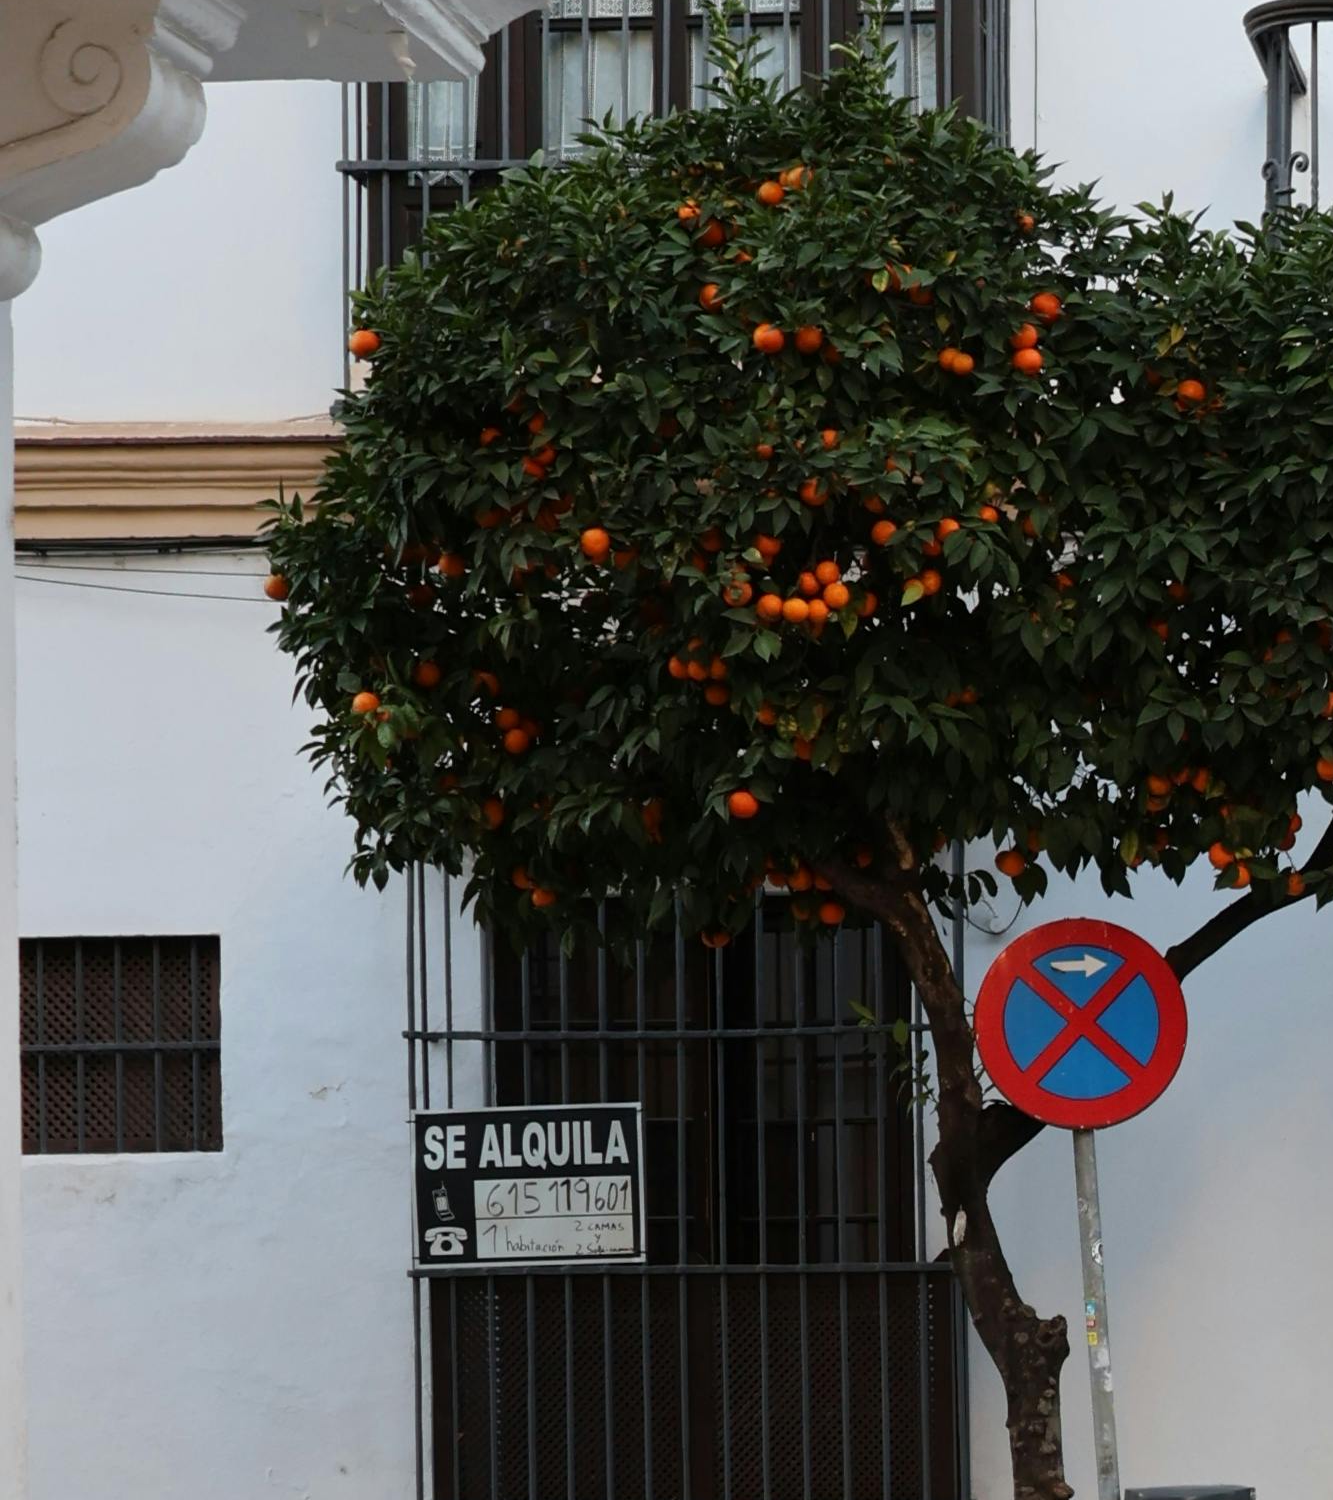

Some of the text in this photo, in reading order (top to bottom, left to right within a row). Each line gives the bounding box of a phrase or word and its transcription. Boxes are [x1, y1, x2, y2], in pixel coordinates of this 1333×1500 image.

[423, 1120, 629, 1170] SE ALQUILA
[483, 1225, 498, 1253] 1
[505, 1226, 565, 1252] habitación
